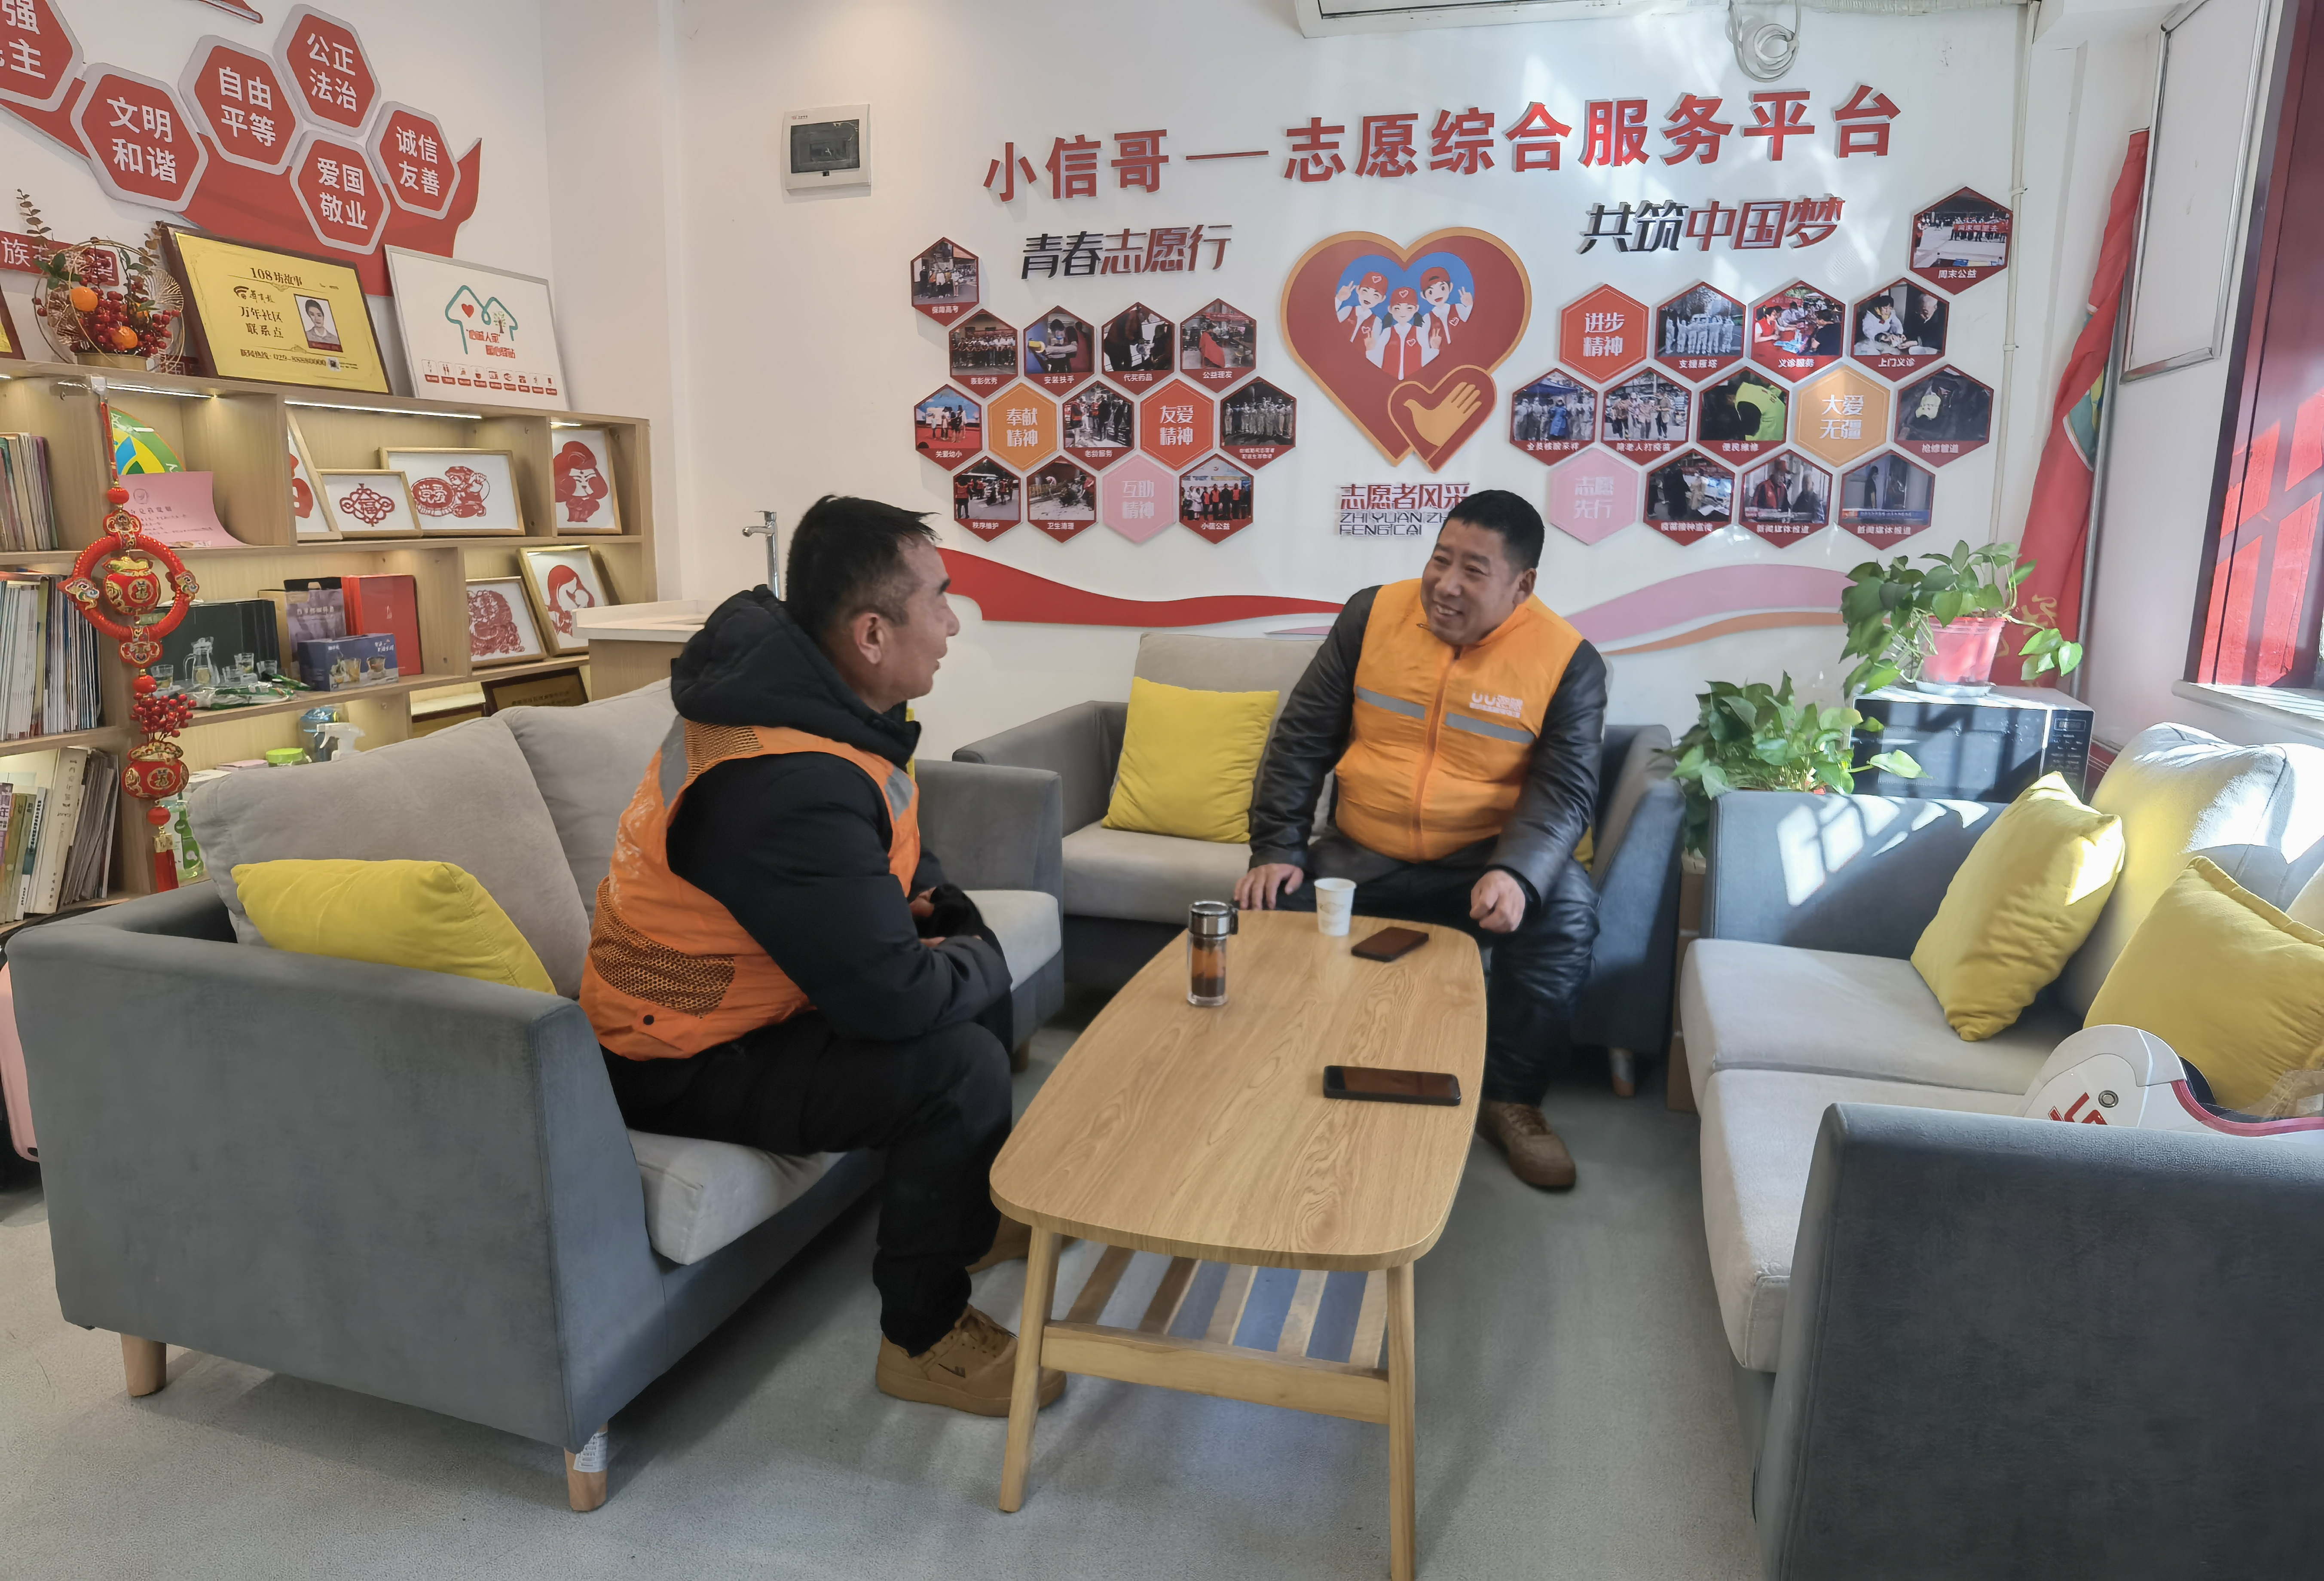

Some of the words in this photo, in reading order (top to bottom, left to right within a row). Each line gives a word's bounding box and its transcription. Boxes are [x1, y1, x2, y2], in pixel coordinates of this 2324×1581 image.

[0, 38, 46, 79] 主
[307, 33, 356, 76] 公正
[219, 67, 272, 111] 自由
[310, 73, 358, 113] 法治
[107, 97, 172, 143] 文明
[221, 104, 276, 147] 平等
[395, 126, 438, 164] 诚信
[113, 139, 177, 184] 和谐
[317, 157, 365, 196] 爱国
[398, 161, 440, 197] 友善
[319, 192, 368, 230] 敬业
[1581, 194, 1846, 254] 共筑中国梦
[1021, 224, 1232, 280] 青春志愿行
[1938, 269, 1977, 278] 周末公益
[1585, 312, 1624, 333] 进步
[1583, 336, 1623, 357] 精神
[1778, 358, 1815, 367] 义诊服务
[1878, 358, 1916, 367] 上门义诊
[1044, 375, 1074, 384] 安装扶手
[1160, 405, 1194, 424] 友爱
[1821, 394, 1864, 415] 大爱
[1006, 408, 1038, 426] 奉献
[1007, 429, 1038, 447] 精神
[1160, 427, 1194, 446] 精神
[1819, 419, 1862, 440] 无疆
[1122, 480, 1155, 498] 互助
[1575, 476, 1615, 495] 志愿
[1340, 483, 1470, 510] 志愿者风采
[1122, 501, 1155, 519] 精神
[1574, 499, 1613, 519] 先行
